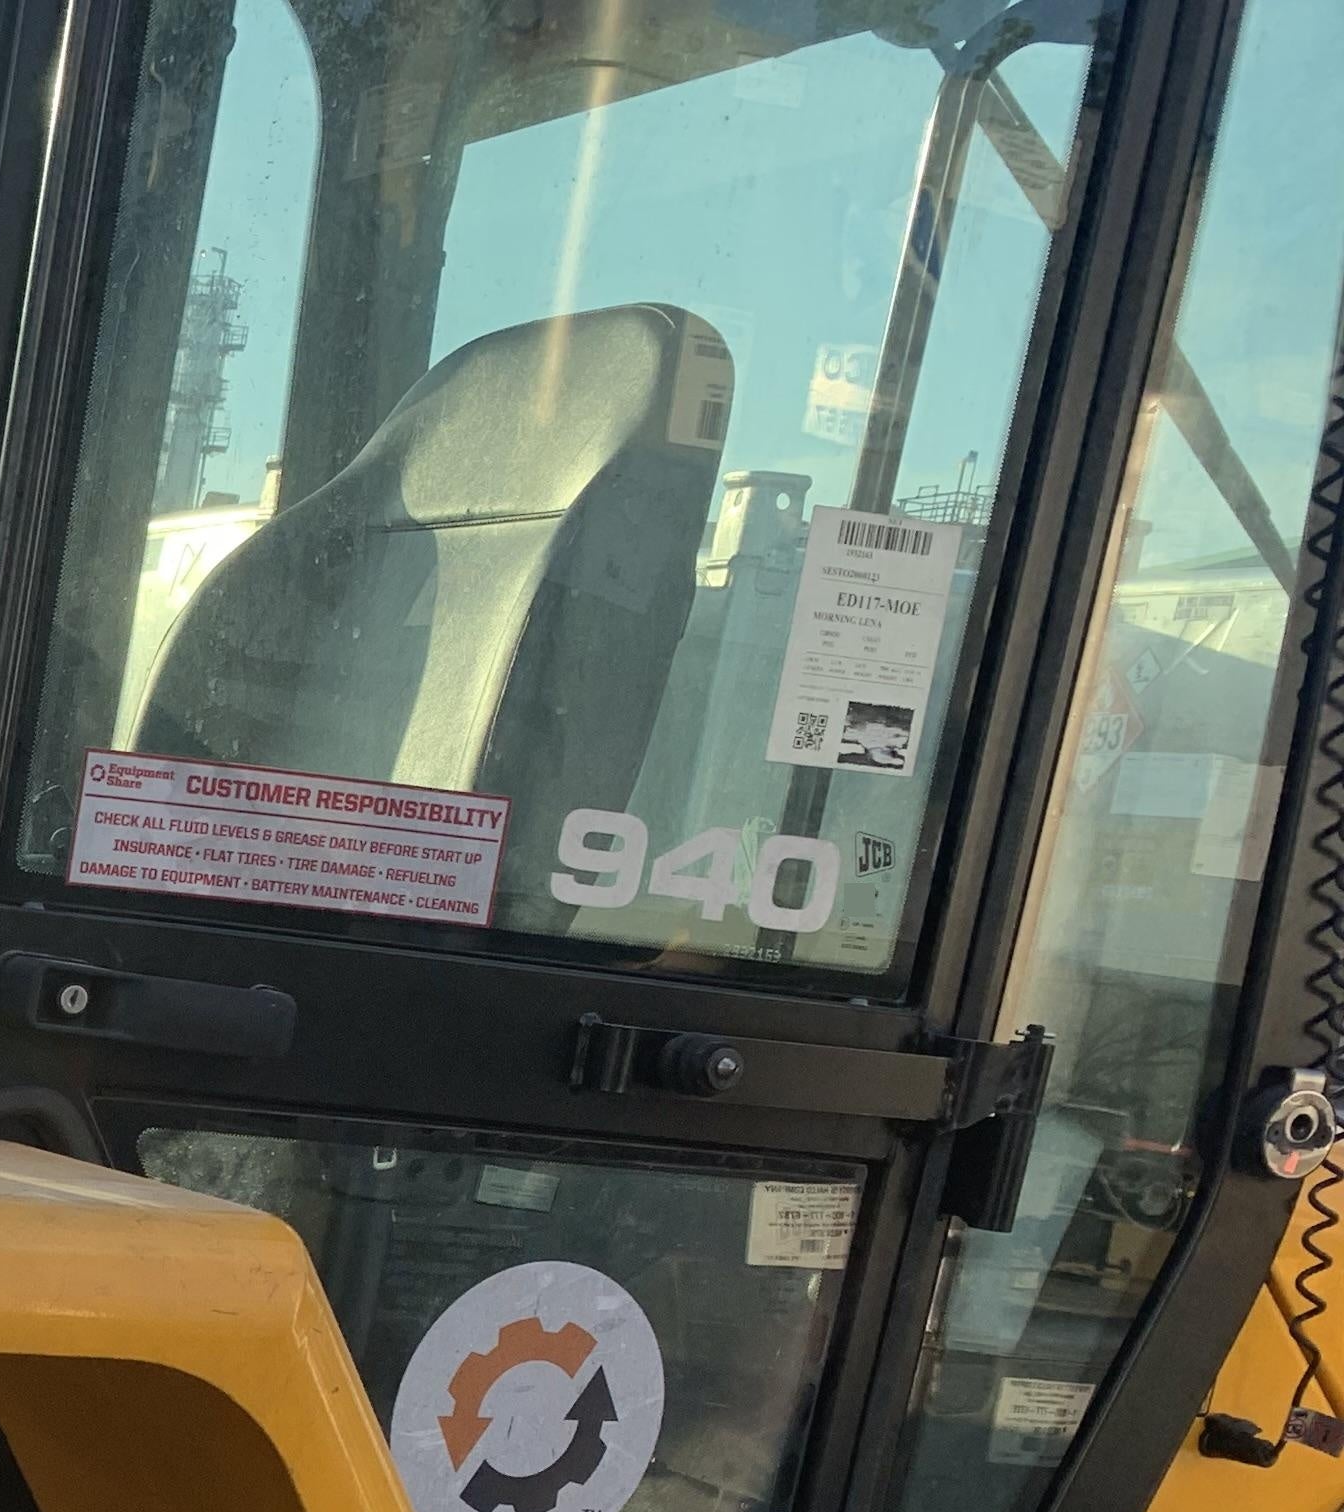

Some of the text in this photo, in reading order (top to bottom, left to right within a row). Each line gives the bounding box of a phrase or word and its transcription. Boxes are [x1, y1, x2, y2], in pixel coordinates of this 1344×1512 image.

[107, 775, 142, 789] Share
[108, 763, 175, 781] Equipment
[186, 775, 502, 829] CUSTOMER RESPONSIBILITY
[94, 811, 139, 827] CHECK
[142, 816, 166, 831] ALL
[169, 819, 209, 835] FLUID
[212, 824, 259, 841] LEVELS
[275, 829, 327, 848] GREASE
[329, 836, 367, 852] DAILY
[370, 841, 419, 859] BEFORE
[422, 848, 462, 864] START
[465, 853, 482, 865] UP
[113, 839, 457, 887] INSURANCE FLAT TIRES TIRE DAMAGE REFUELING
[858, 835, 893, 873] JCB
[80, 861, 480, 915] DAMAGE TO EQUIPMENT BATTERY MAINTENANCE CLEANING
[550, 808, 840, 933] 940
